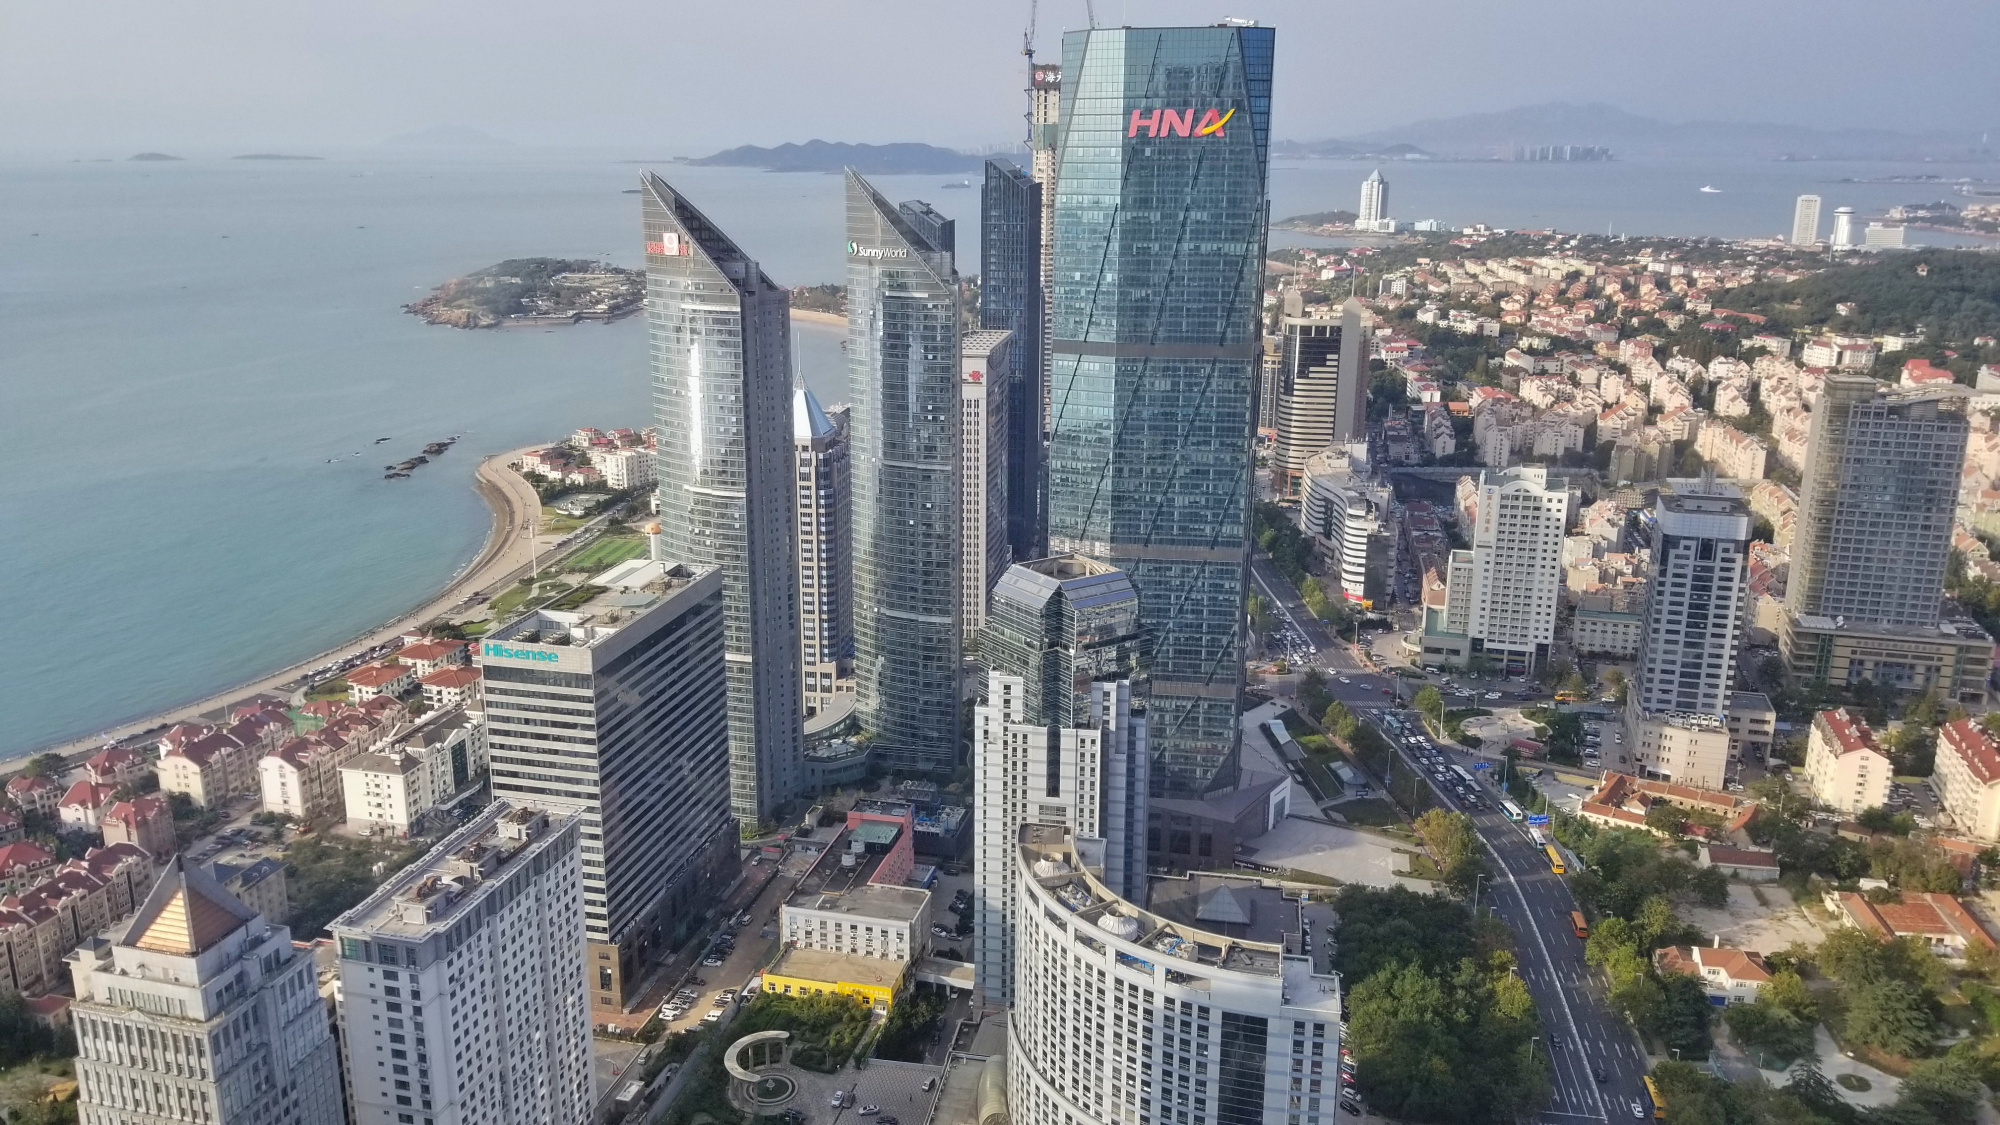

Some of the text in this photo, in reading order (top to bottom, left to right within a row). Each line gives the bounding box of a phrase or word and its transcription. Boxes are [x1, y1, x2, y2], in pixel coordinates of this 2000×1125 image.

[1128, 108, 1235, 137] HNA
[859, 246, 907, 260] SunnyWorld
[484, 643, 559, 663] Hisense
